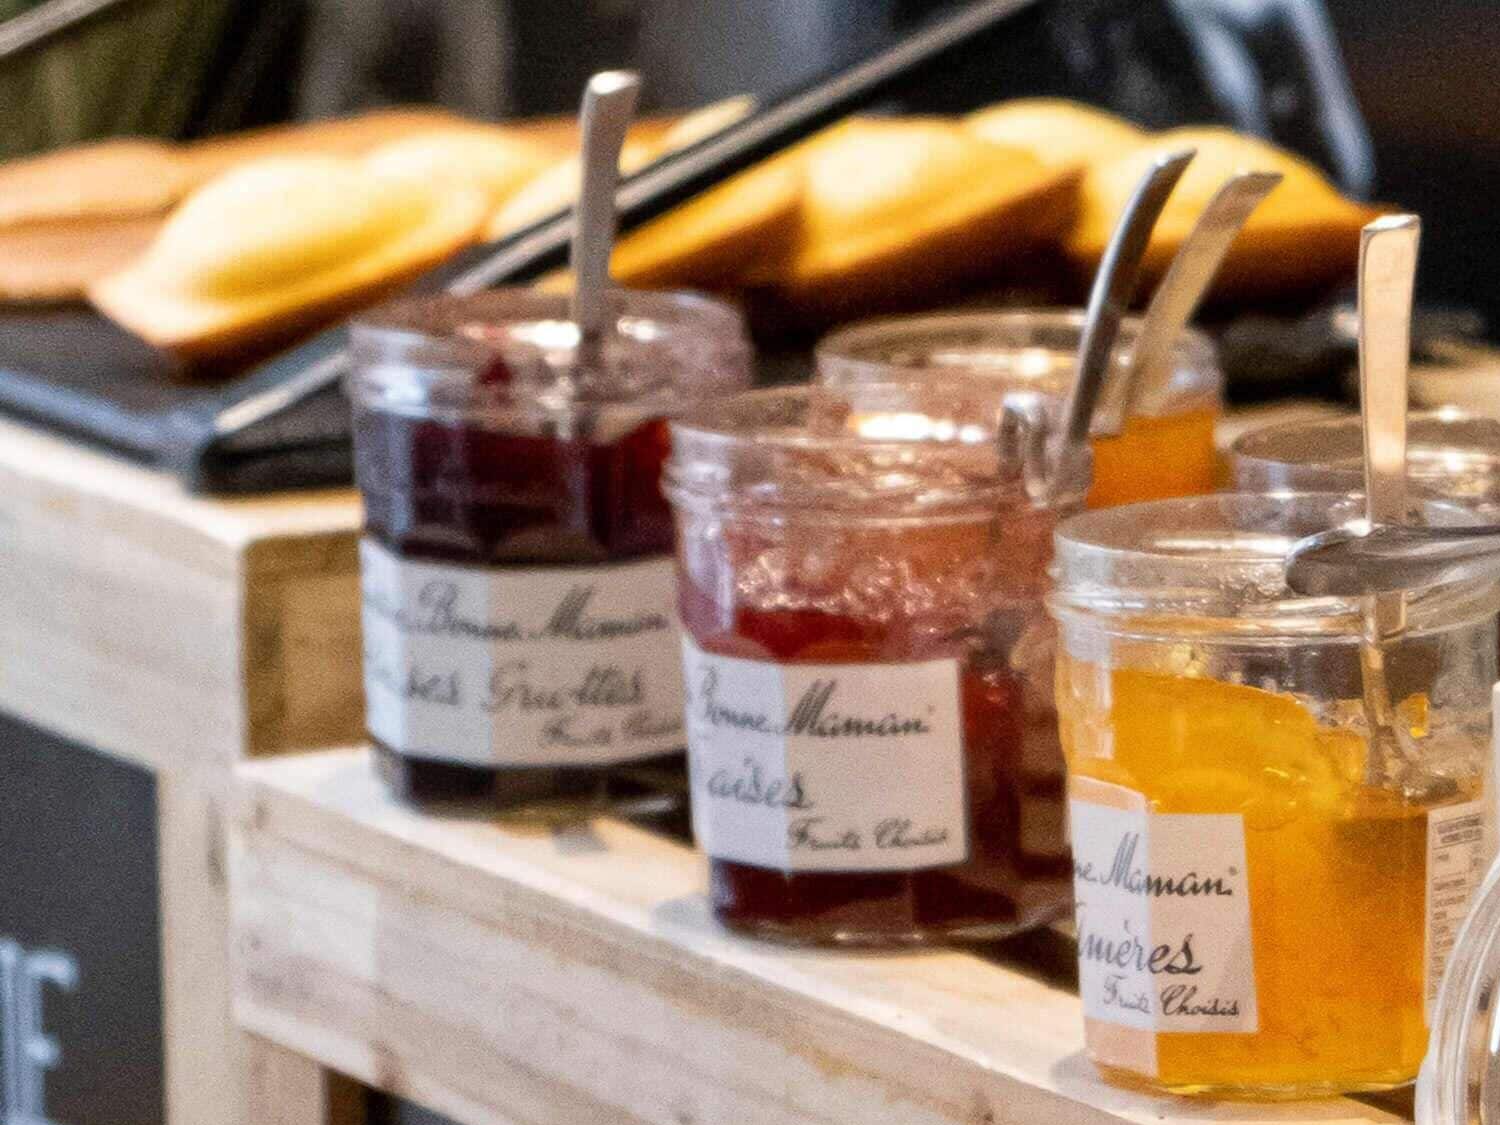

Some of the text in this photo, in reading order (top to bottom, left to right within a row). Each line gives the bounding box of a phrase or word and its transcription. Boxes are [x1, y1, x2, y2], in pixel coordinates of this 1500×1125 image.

[784, 678, 929, 738] Maman
[706, 755, 814, 810] aises
[1100, 831, 1233, 898] Maman
[1078, 912, 1204, 976] mères
[1102, 975, 1241, 1018] Fruits Choisis
